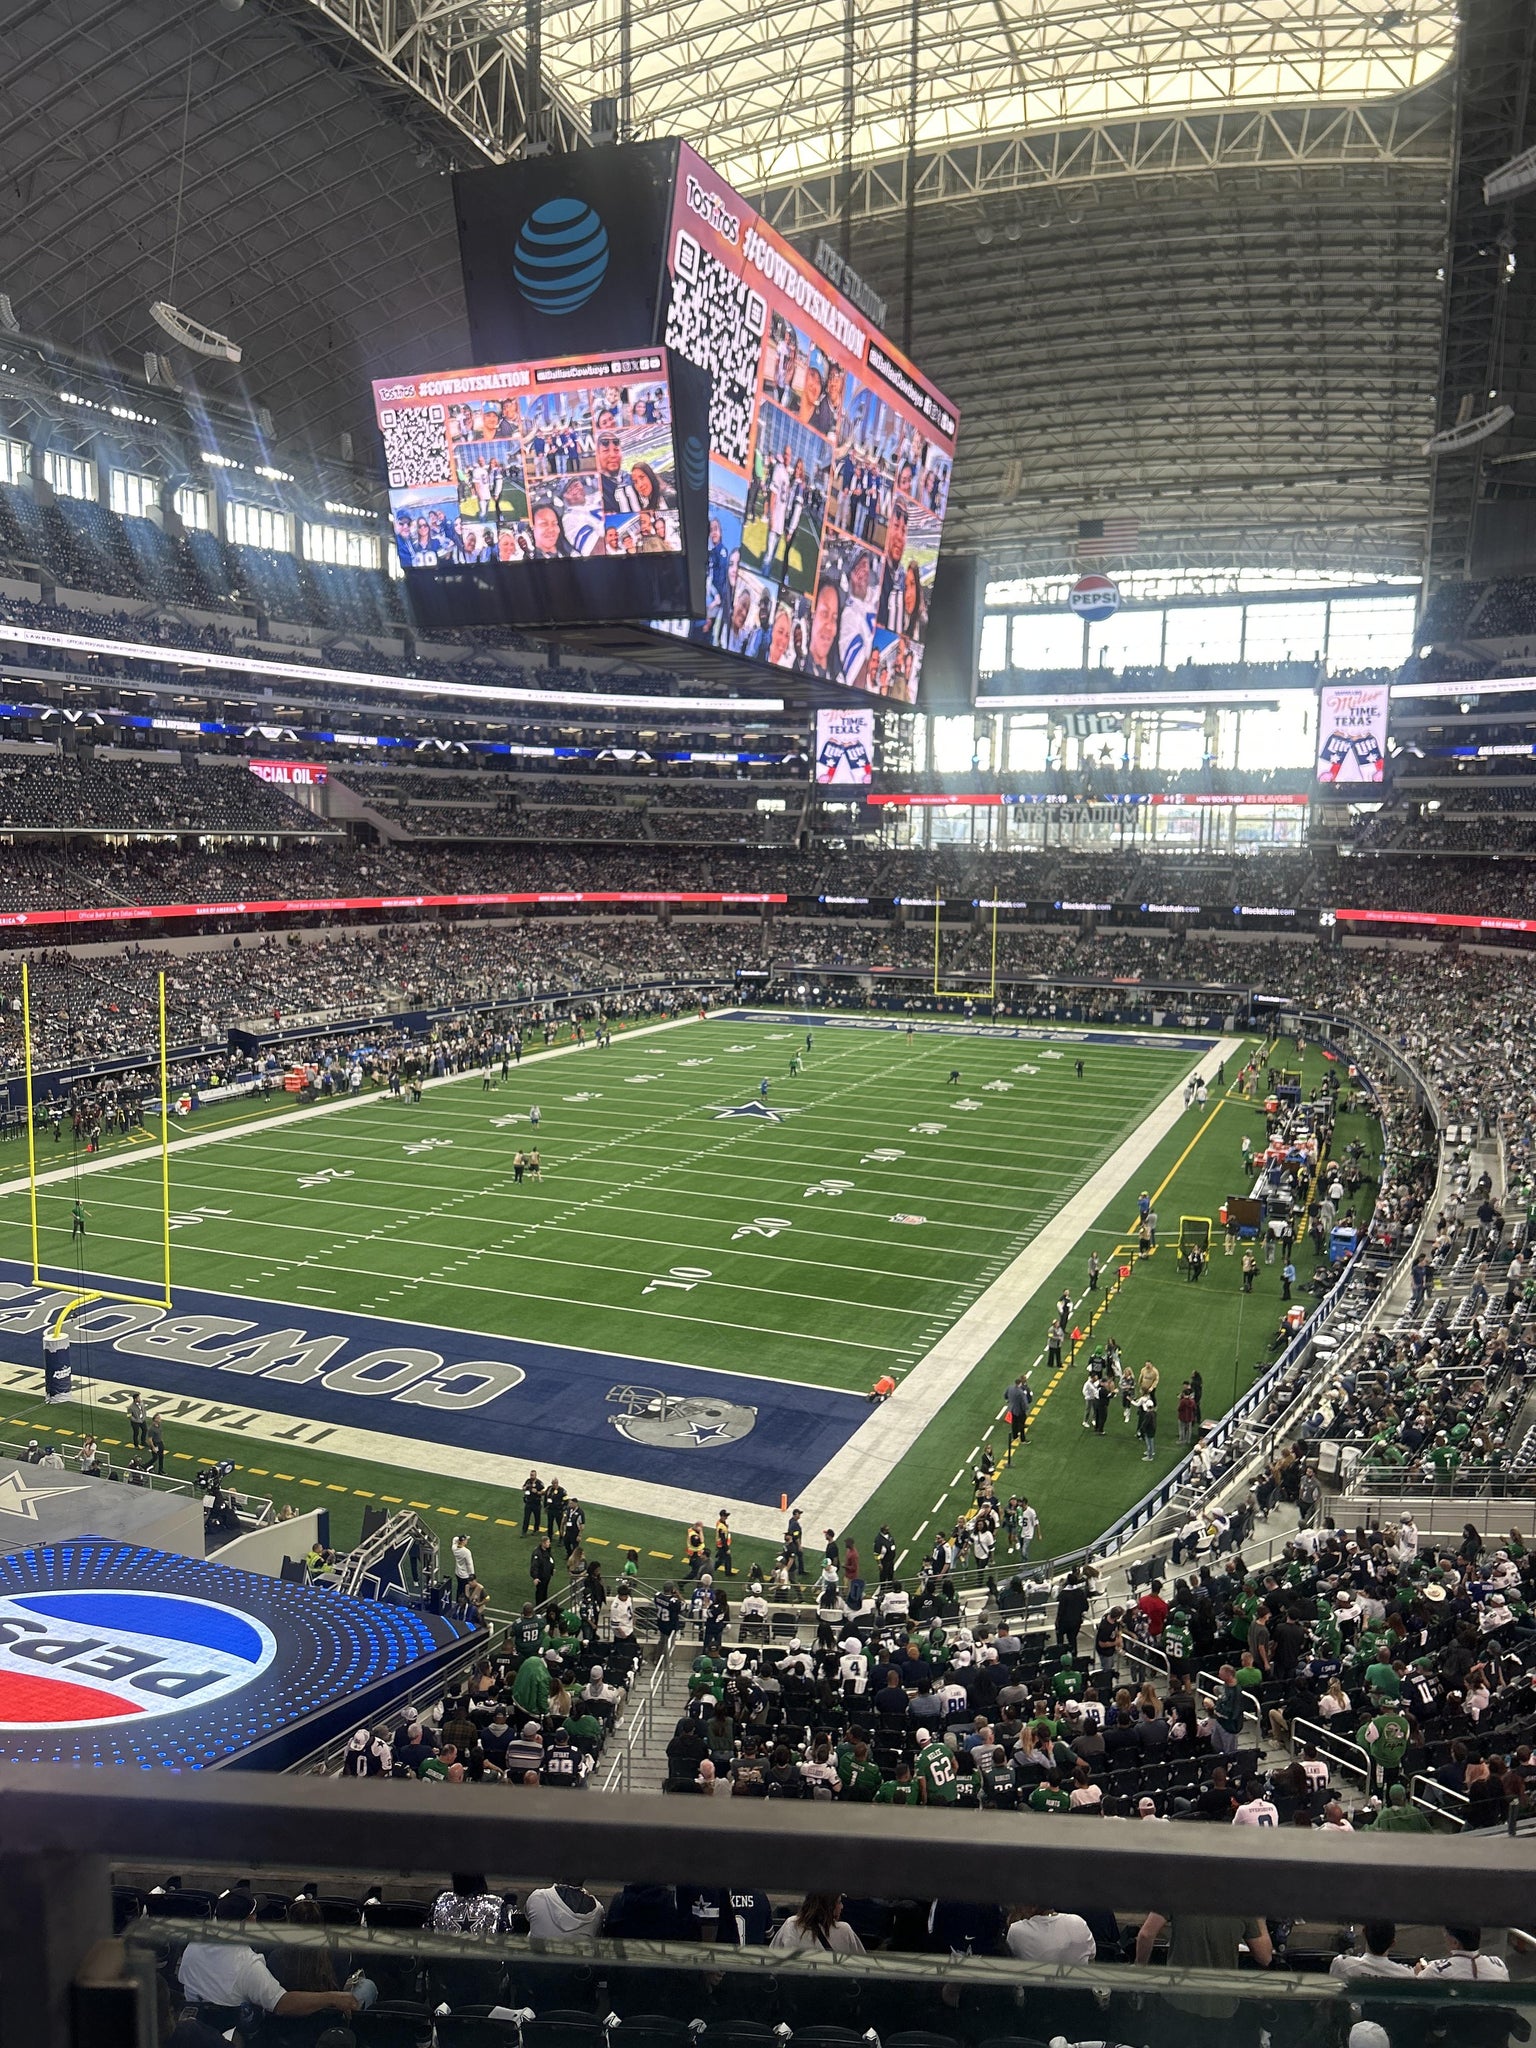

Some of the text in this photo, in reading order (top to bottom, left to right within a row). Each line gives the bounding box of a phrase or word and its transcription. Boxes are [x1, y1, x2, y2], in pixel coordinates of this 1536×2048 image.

[742, 227, 867, 360] #COWBOYSNATION
[418, 370, 531, 397] #COWBOYSNATION
[1072, 593, 1118, 606] PEPSI
[1350, 707, 1381, 718] TIME,
[829, 725, 860, 734] TEXAS
[841, 717, 867, 726] TIME,
[1335, 716, 1372, 727] TEXAS
[293, 768, 313, 784] OIL
[1257, 795, 1293, 804] FLAVORS
[1014, 805, 1139, 824] AT&T STADIUM
[1149, 903, 1200, 913] Blockchain.com
[1241, 906, 1295, 916] Blockchain.com
[402, 1138, 453, 1152] 30
[869, 1148, 906, 1163] 40
[297, 1168, 355, 1185] 20
[807, 1179, 855, 1196] 30
[168, 1206, 232, 1226] 10
[738, 1217, 793, 1239] 20
[651, 1266, 713, 1292] 10
[90, 1389, 264, 1433] TAKES
[271, 1427, 339, 1446] IT
[523, 1630, 539, 1642] 98
[1165, 1639, 1183, 1658] 26
[850, 1661, 860, 1676] 4
[1417, 1683, 1434, 1704] 11
[356, 1755, 368, 1777] 0
[929, 1756, 955, 1787] 62
